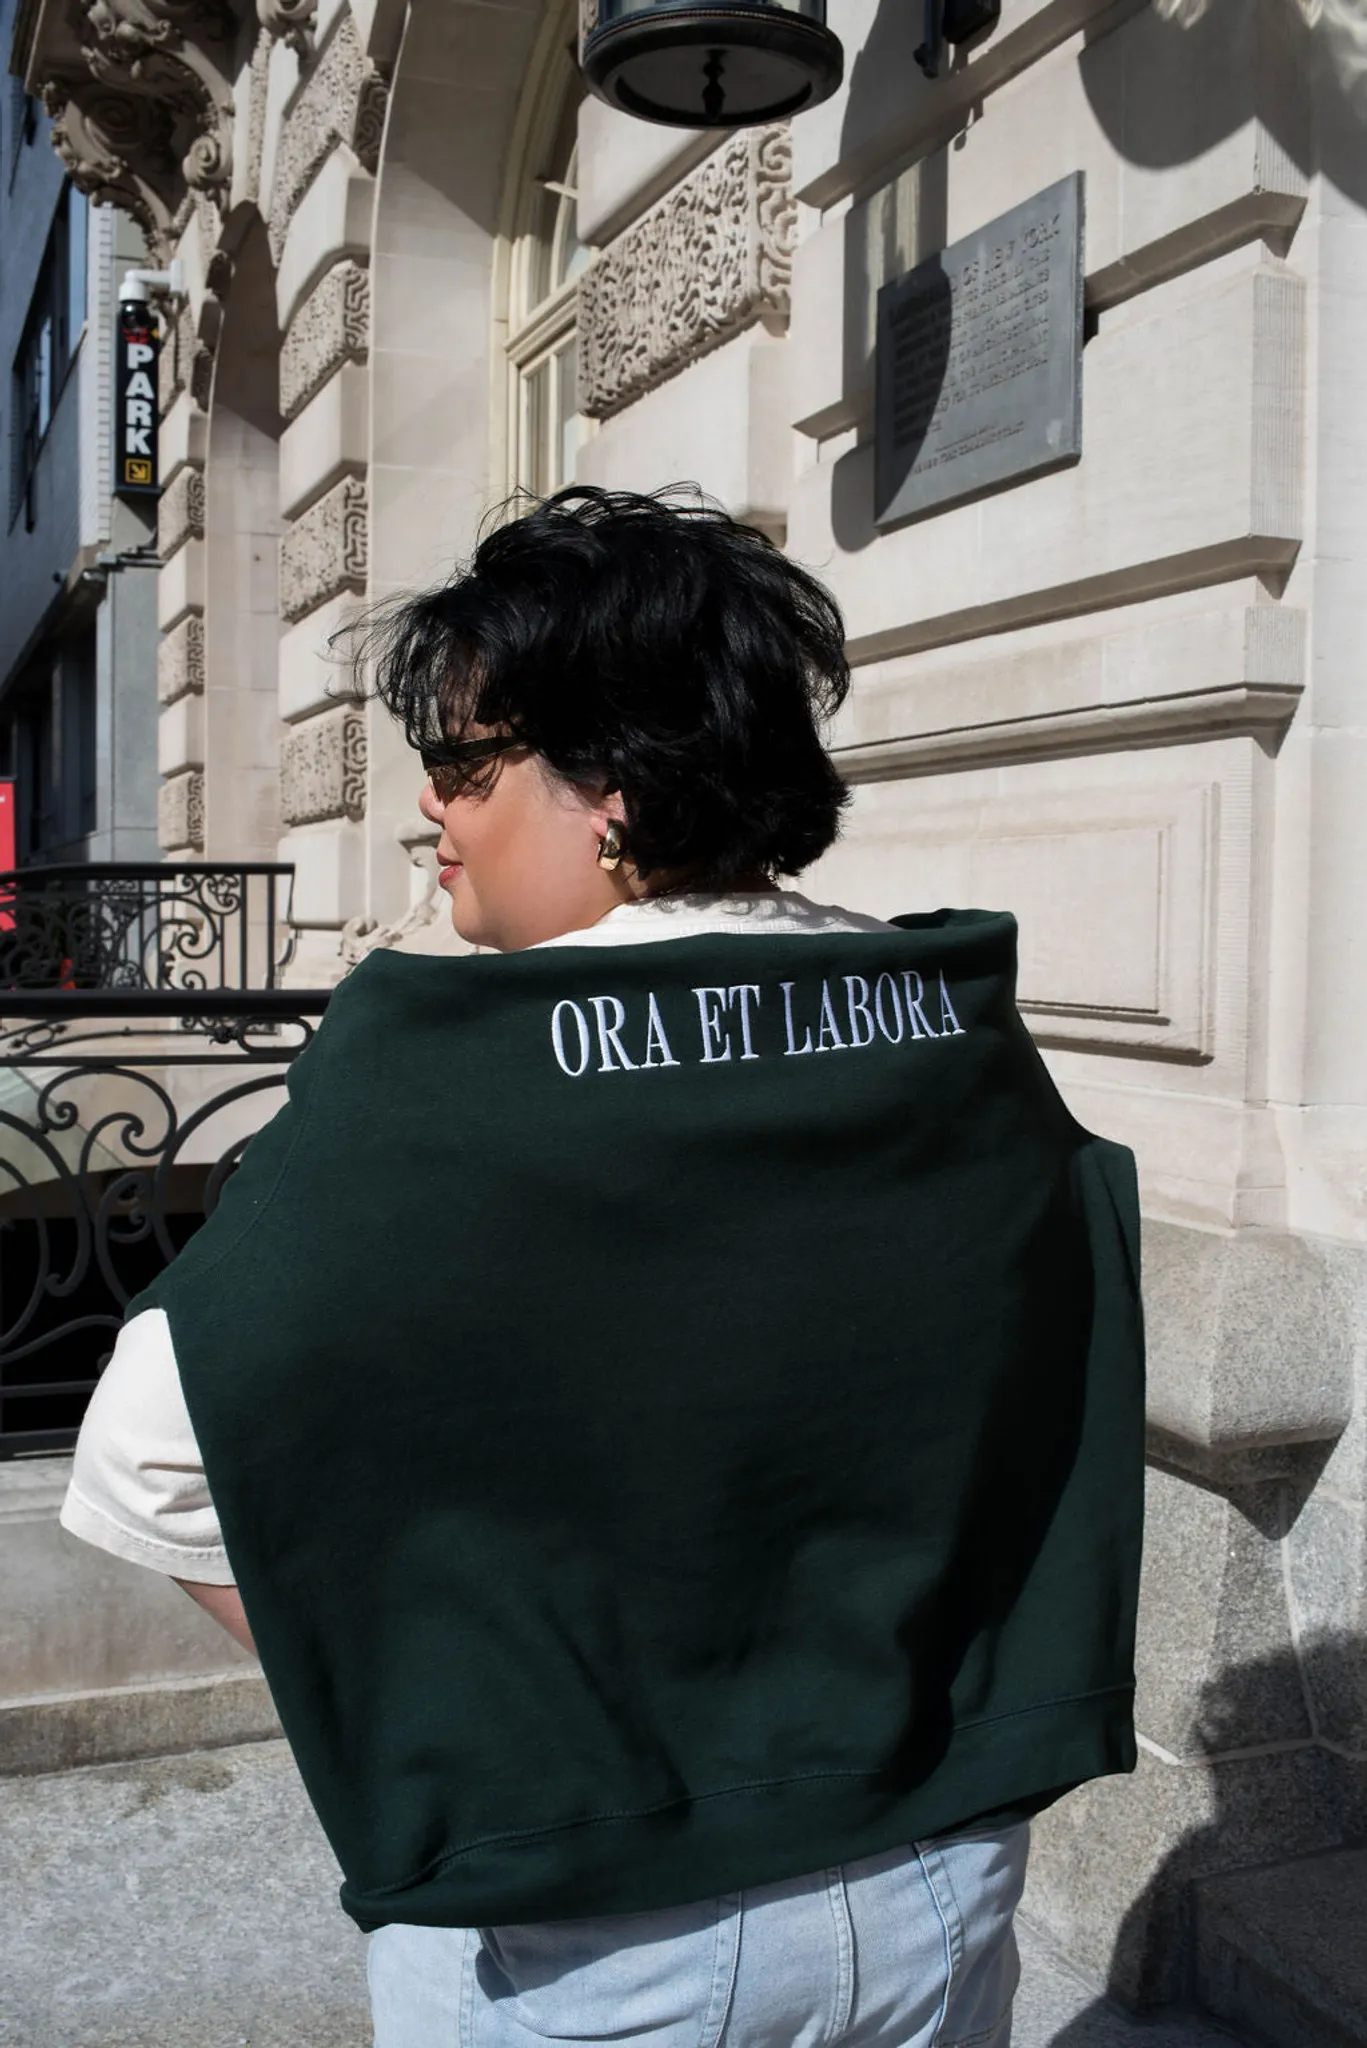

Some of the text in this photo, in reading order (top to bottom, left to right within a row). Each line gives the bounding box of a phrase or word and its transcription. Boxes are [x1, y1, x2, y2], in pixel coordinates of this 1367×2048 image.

[125, 343, 154, 455] PARK
[552, 969, 966, 1077] ORA ET LABORA
